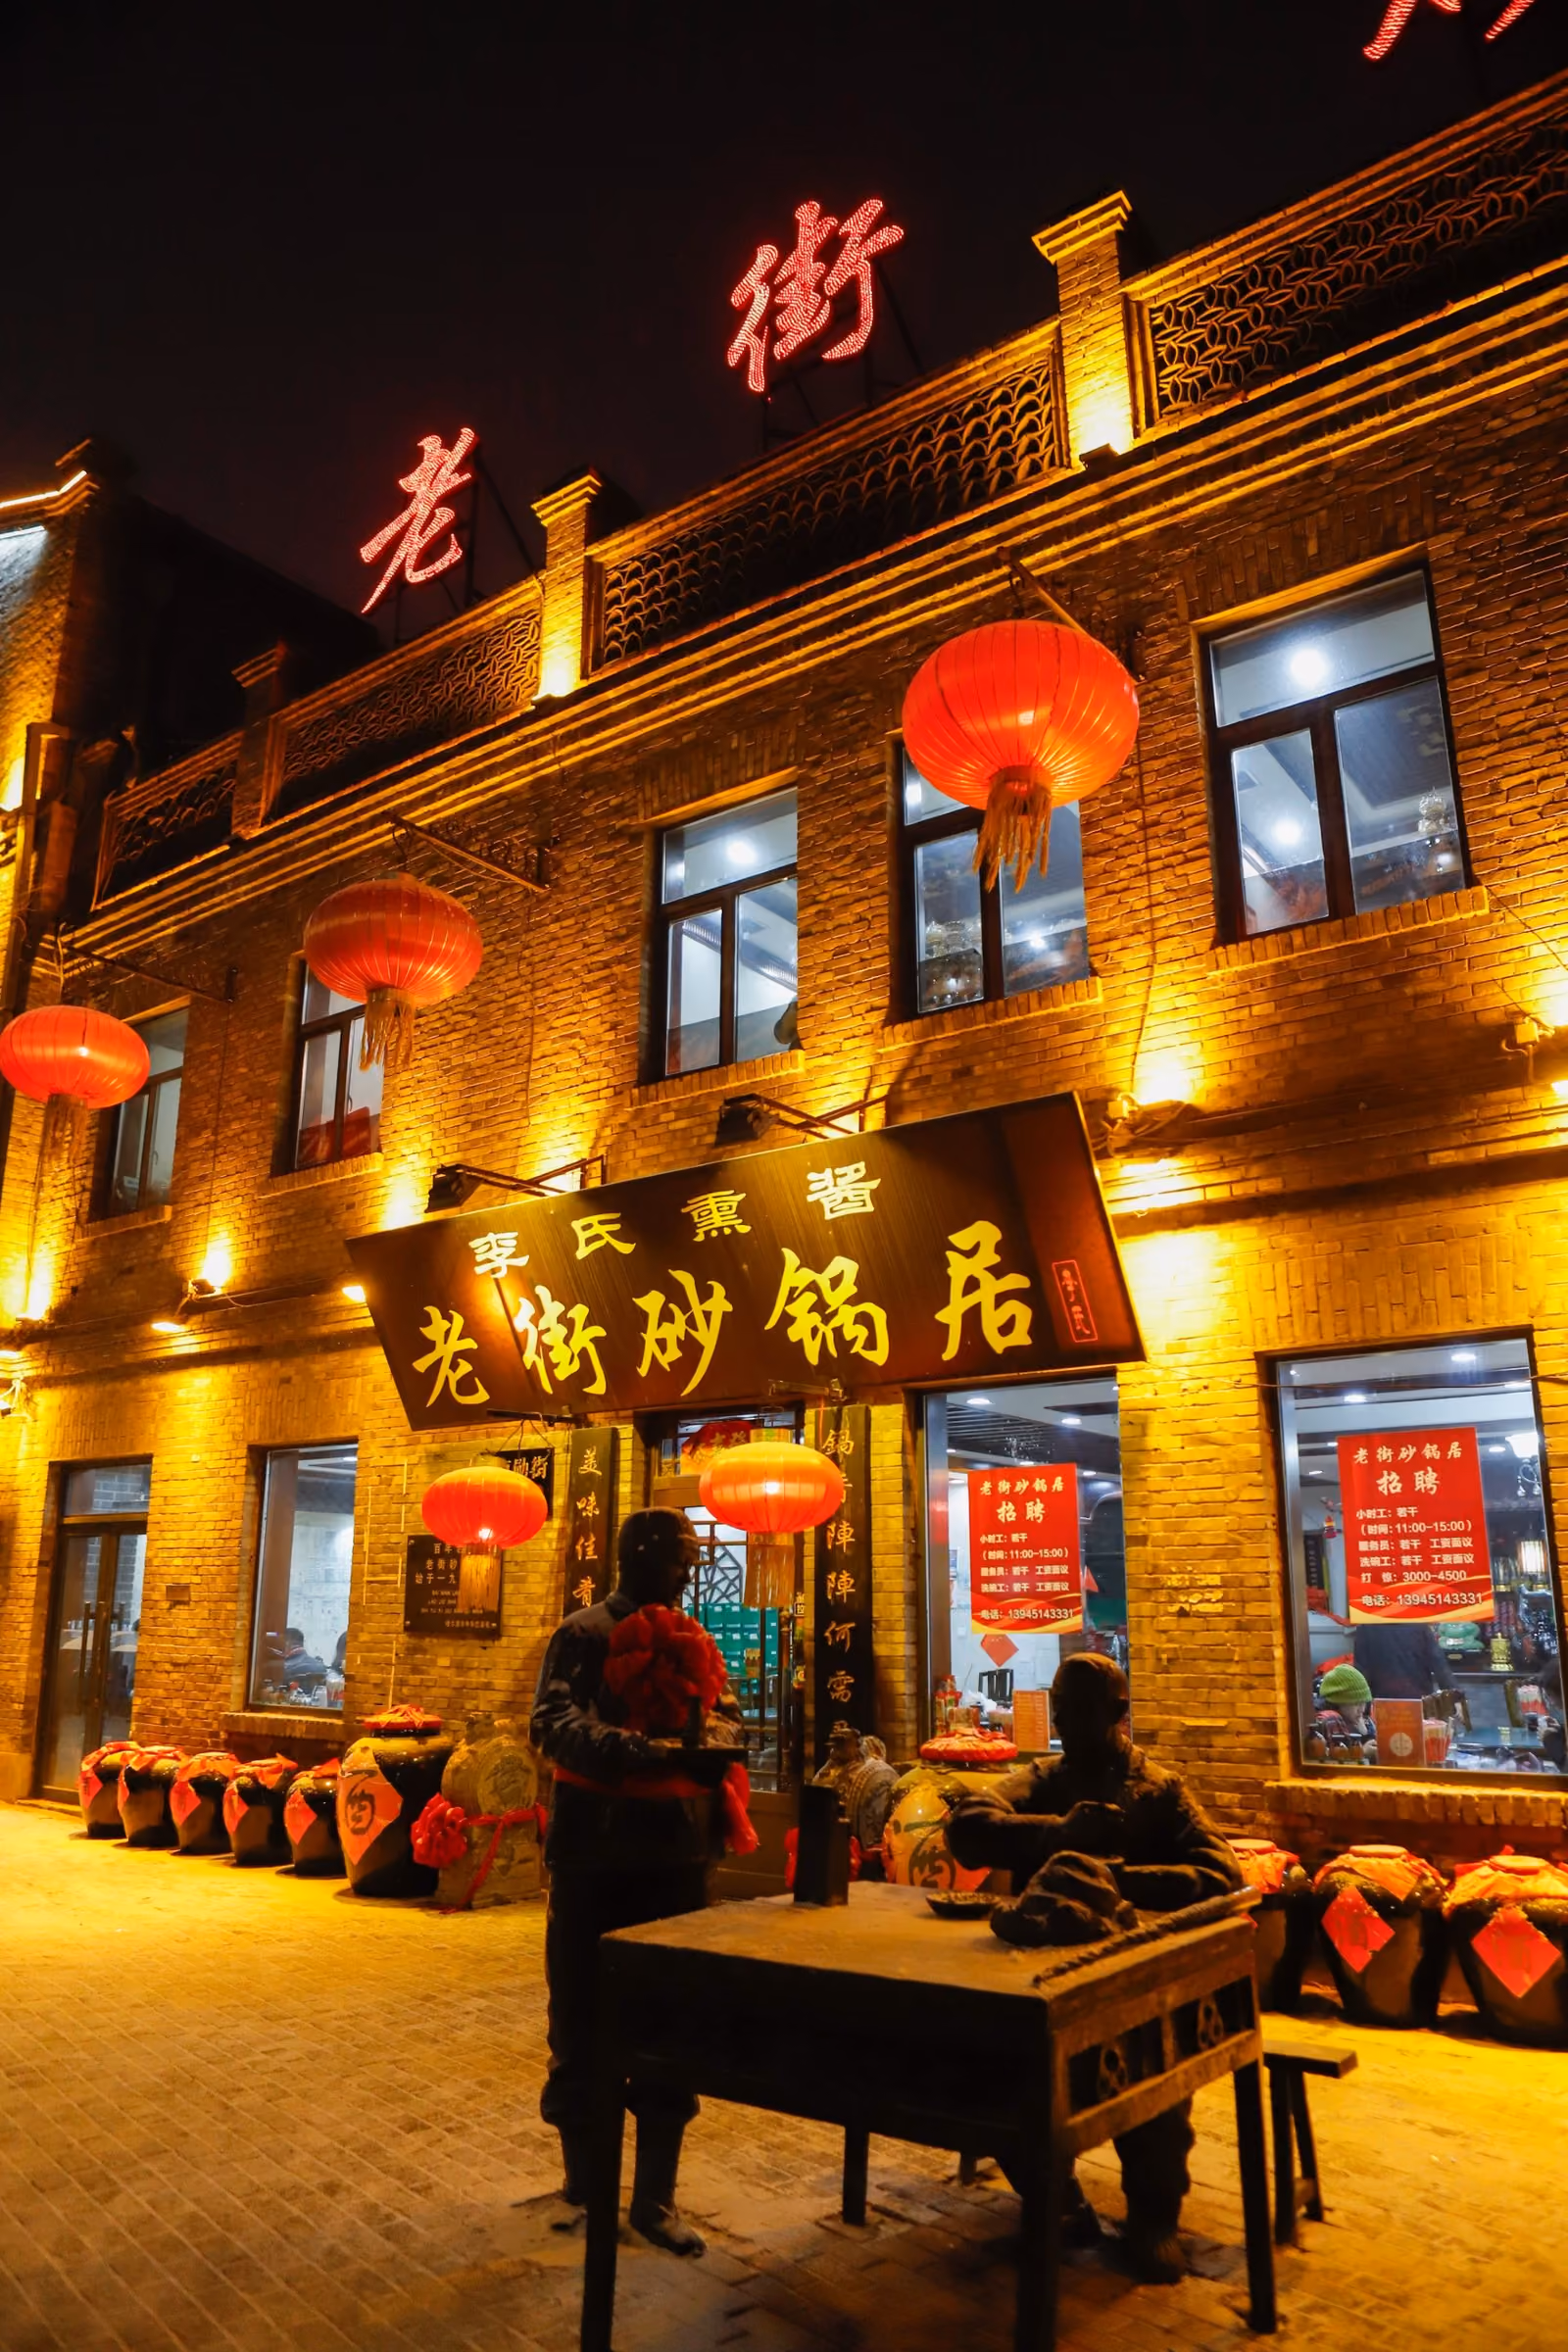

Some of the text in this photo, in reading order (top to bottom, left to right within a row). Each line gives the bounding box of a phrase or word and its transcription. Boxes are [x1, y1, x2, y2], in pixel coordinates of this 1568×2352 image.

[412, 1219, 1034, 1409] 老街砂锅居
[1353, 1441, 1463, 1464] 老街砂锅居
[980, 1476, 1064, 1495] 老街砂锅居
[1376, 1466, 1441, 1496] 招聘
[996, 1497, 1047, 1524] 招聘
